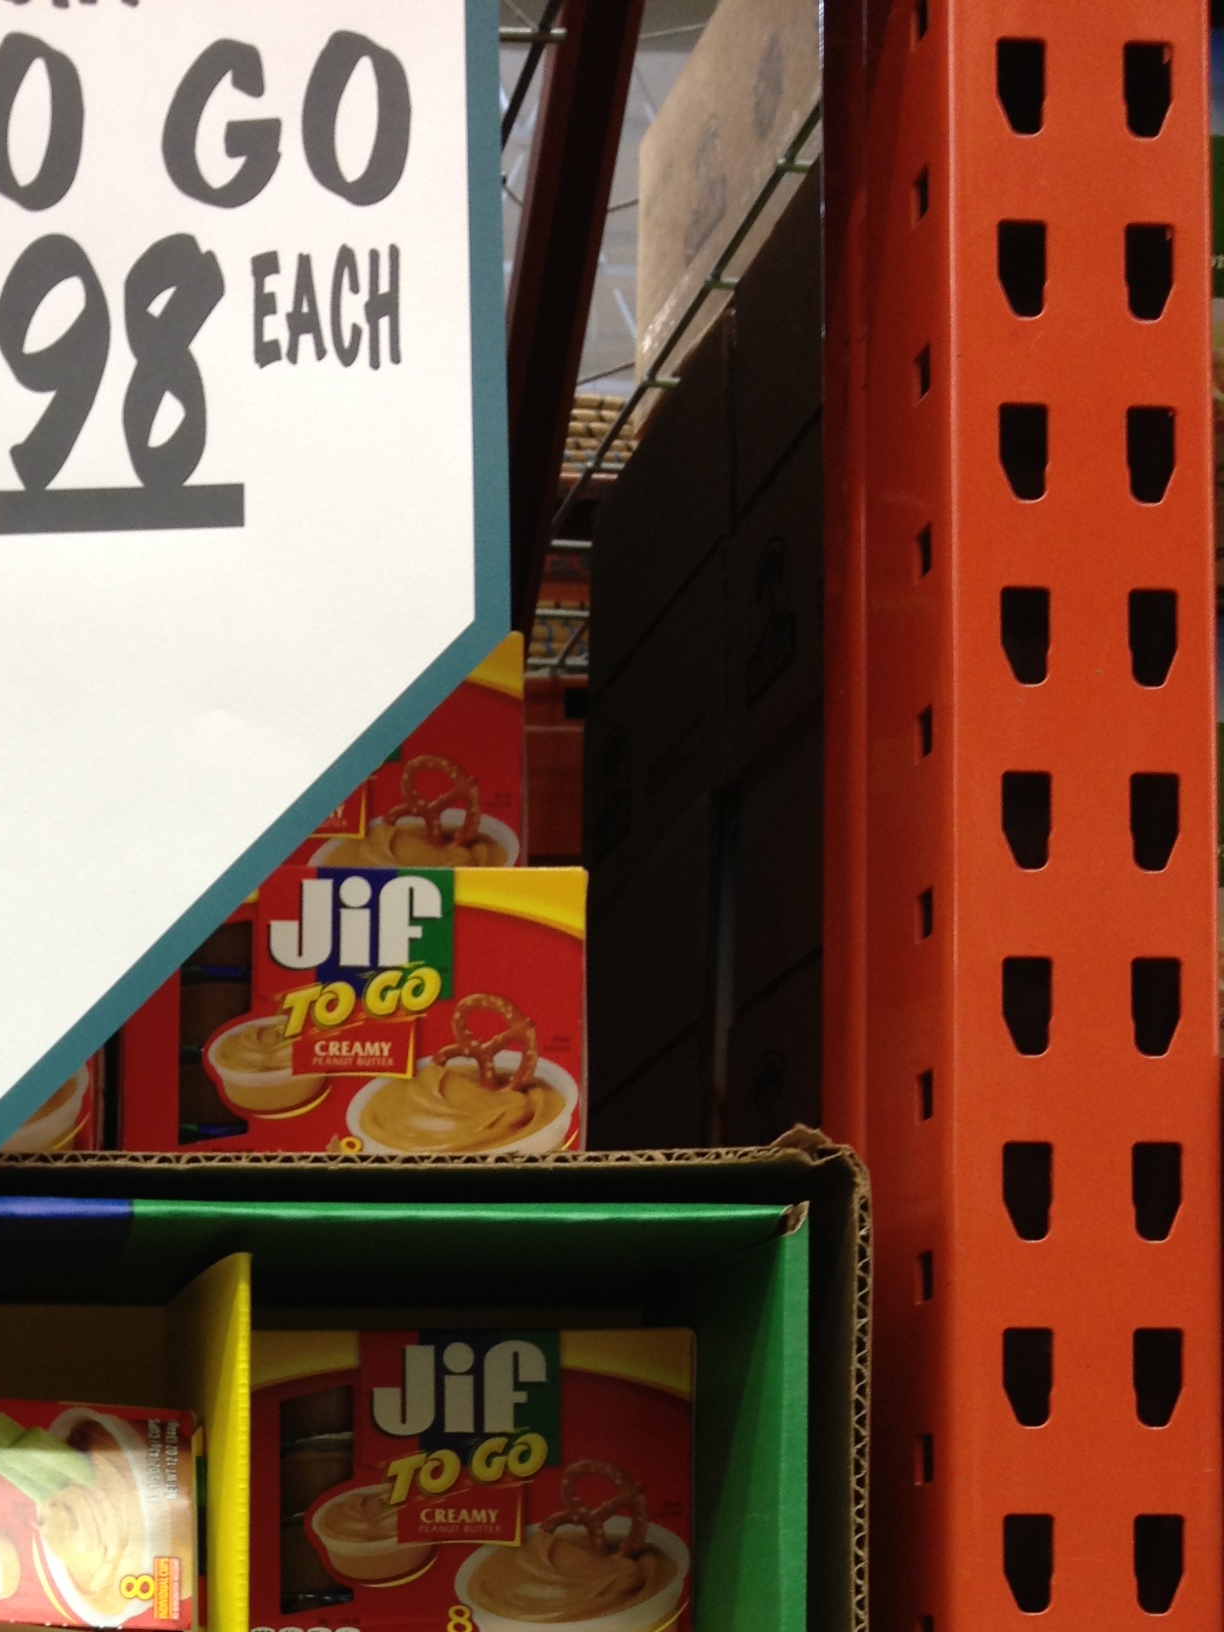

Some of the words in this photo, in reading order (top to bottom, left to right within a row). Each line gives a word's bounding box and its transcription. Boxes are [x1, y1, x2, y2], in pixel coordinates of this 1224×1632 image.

[161, 30, 411, 208] GO
[251, 243, 401, 370] EACH
[270, 876, 442, 969] Jif
[283, 982, 357, 1038] TO
[365, 967, 443, 1016] GO
[314, 1040, 393, 1057] CREAMY
[372, 1339, 548, 1437] Jif
[383, 1448, 462, 1506] TO
[471, 1432, 549, 1483] GO
[420, 1507, 499, 1524] CREAMY
